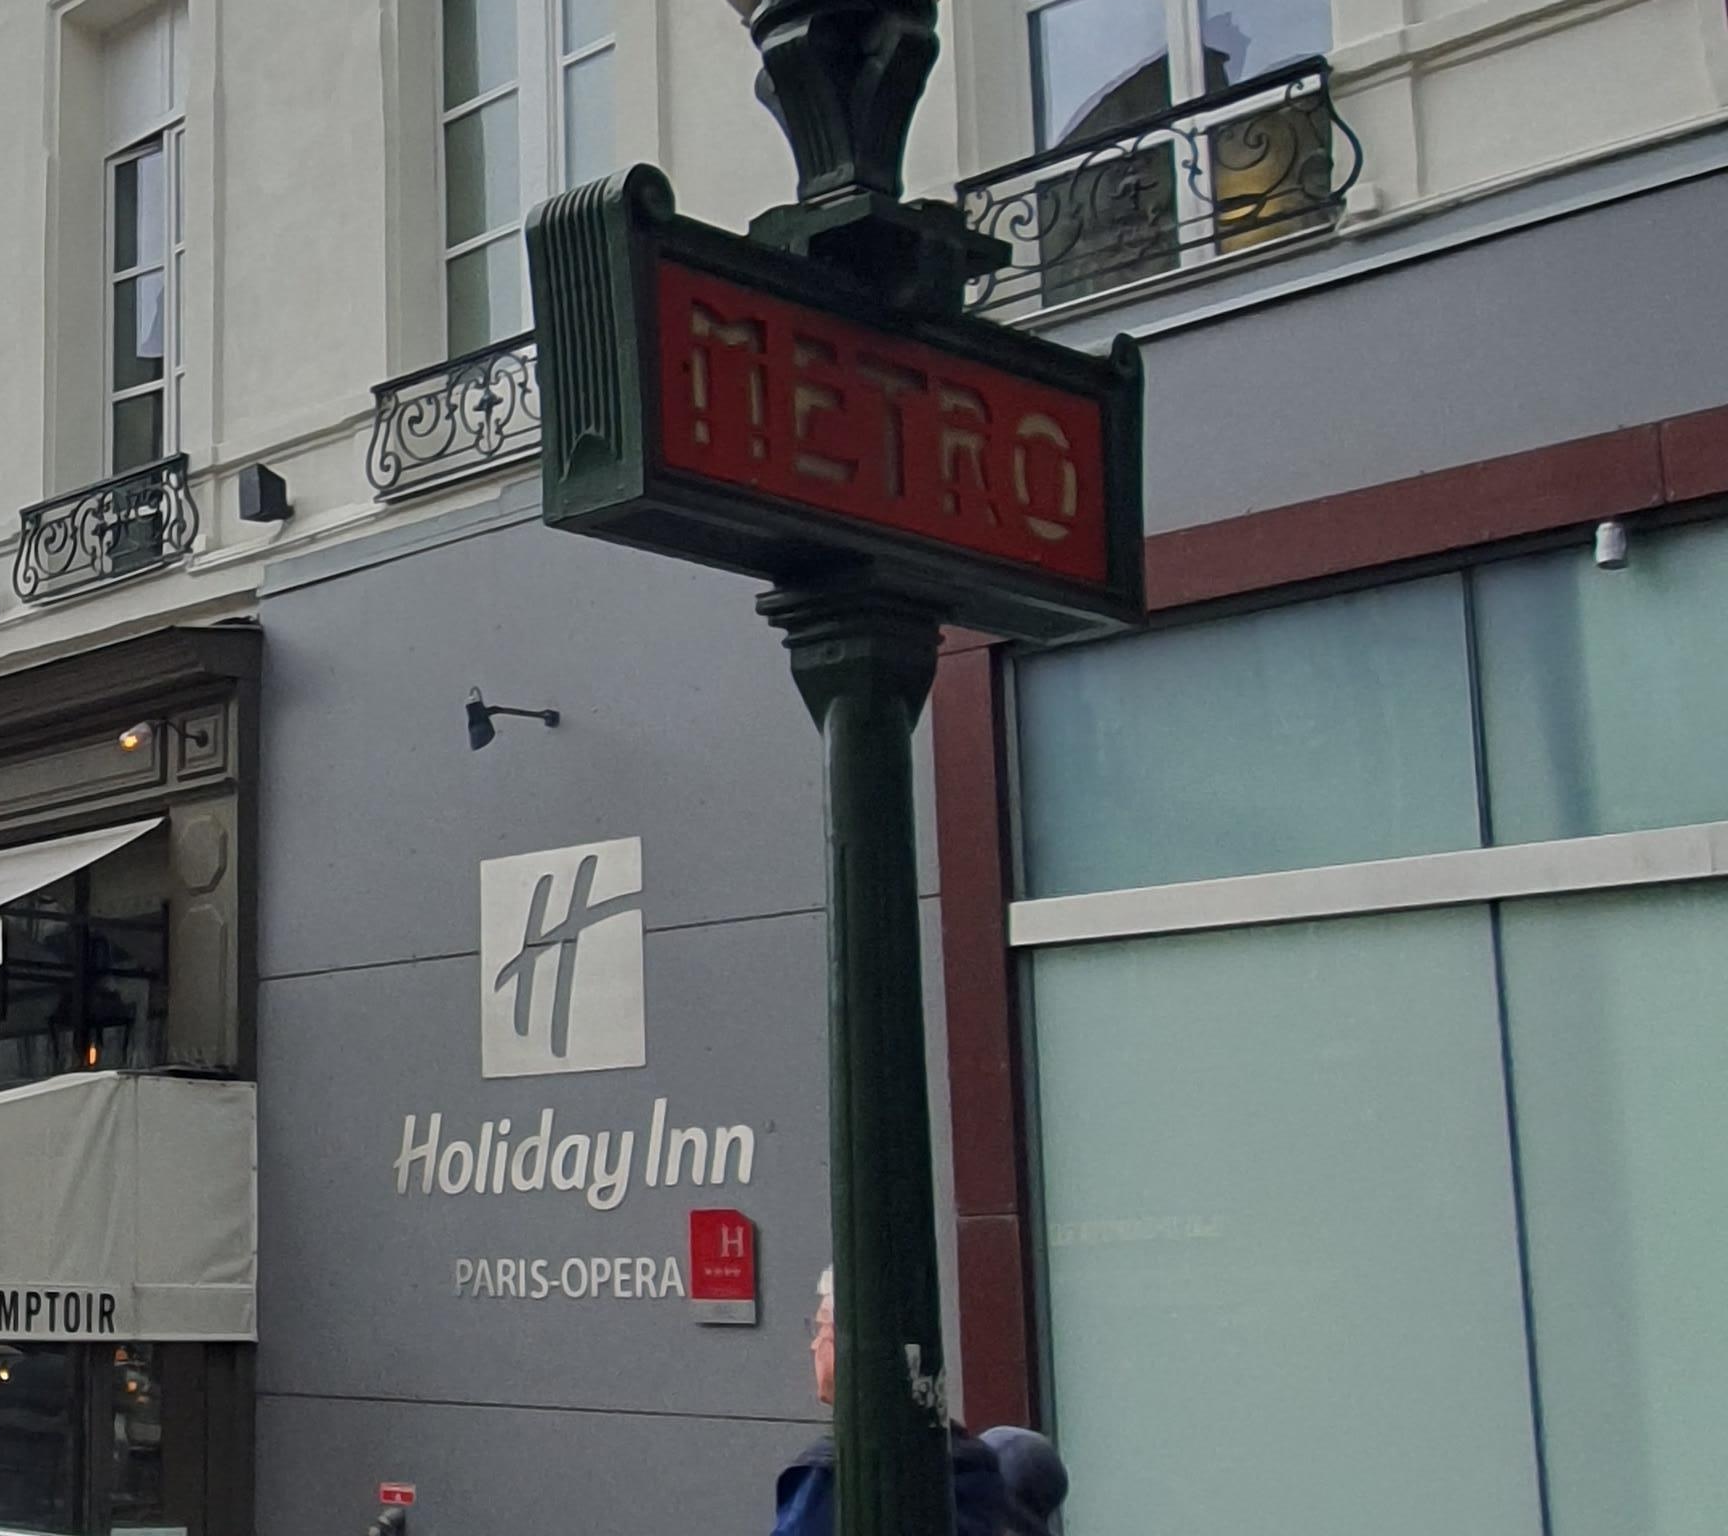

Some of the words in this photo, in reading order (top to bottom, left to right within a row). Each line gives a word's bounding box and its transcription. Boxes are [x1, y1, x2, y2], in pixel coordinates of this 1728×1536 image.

[689, 297, 1078, 541] METRO
[393, 1106, 634, 1210] Holiday
[644, 1097, 754, 1187] Inn
[454, 1256, 686, 1300] PARIS-OPERA
[720, 1224, 745, 1259] H
